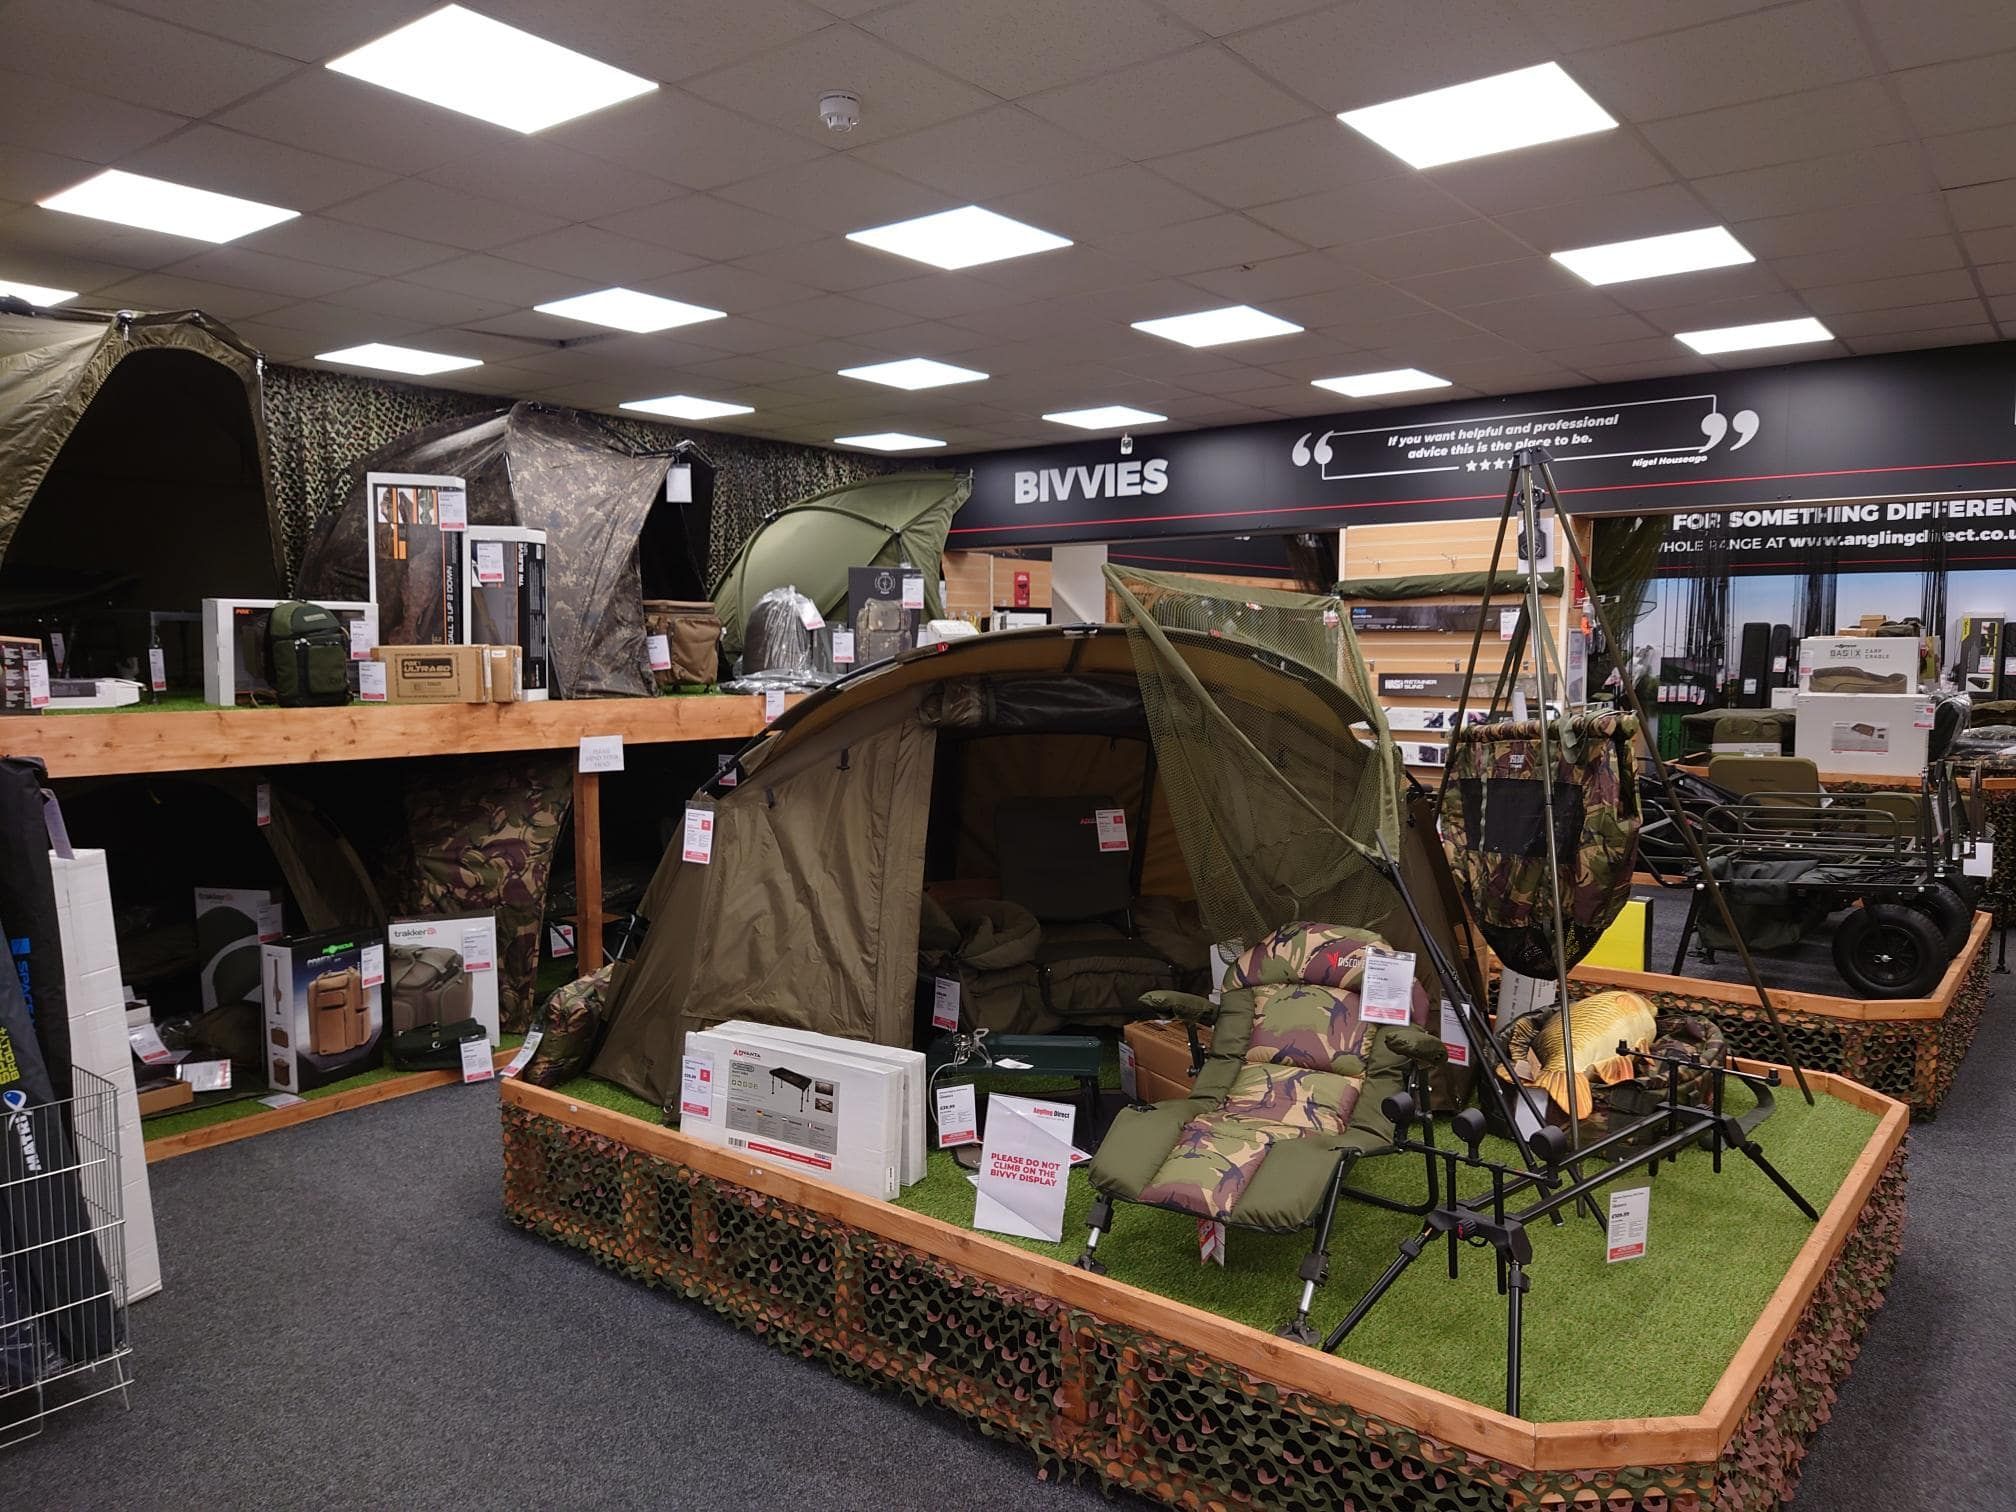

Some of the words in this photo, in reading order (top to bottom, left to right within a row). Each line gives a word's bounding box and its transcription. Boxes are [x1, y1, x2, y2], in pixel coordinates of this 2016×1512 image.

[1388, 436, 1398, 447] If
[1398, 434, 1422, 448] you
[1423, 430, 1456, 444] want
[1457, 425, 1503, 443] helpful
[1505, 422, 1532, 436] and
[1533, 414, 1620, 435] professional
[1407, 445, 1449, 460] advice
[1450, 443, 1475, 456] this
[1476, 441, 1489, 453] is
[1490, 439, 1513, 452] the
[1554, 434, 1569, 447] to
[1571, 432, 1593, 445] be.
[1631, 456, 1657, 468] Nigel
[1658, 453, 1707, 466] Houseago
[1014, 458, 1169, 505] BIVVIES
[1671, 512, 1721, 532] FOR
[1728, 504, 1880, 529] SOMETHING
[1658, 540, 1704, 553] HOLE
[1765, 536, 1786, 549] AT
[394, 927, 426, 938] trakker
[1053, 1108, 1070, 1119] Direct
[991, 1152, 1024, 1165] PLEASE
[1025, 1158, 1040, 1167] DO
[1041, 1160, 1061, 1171] NOT
[993, 1161, 1021, 1172] CLIMB
[1022, 1166, 1038, 1175] ON
[1039, 1168, 1056, 1178] THE
[990, 1168, 1017, 1180] BIVVY
[1018, 1173, 1057, 1187] DISPLAY
